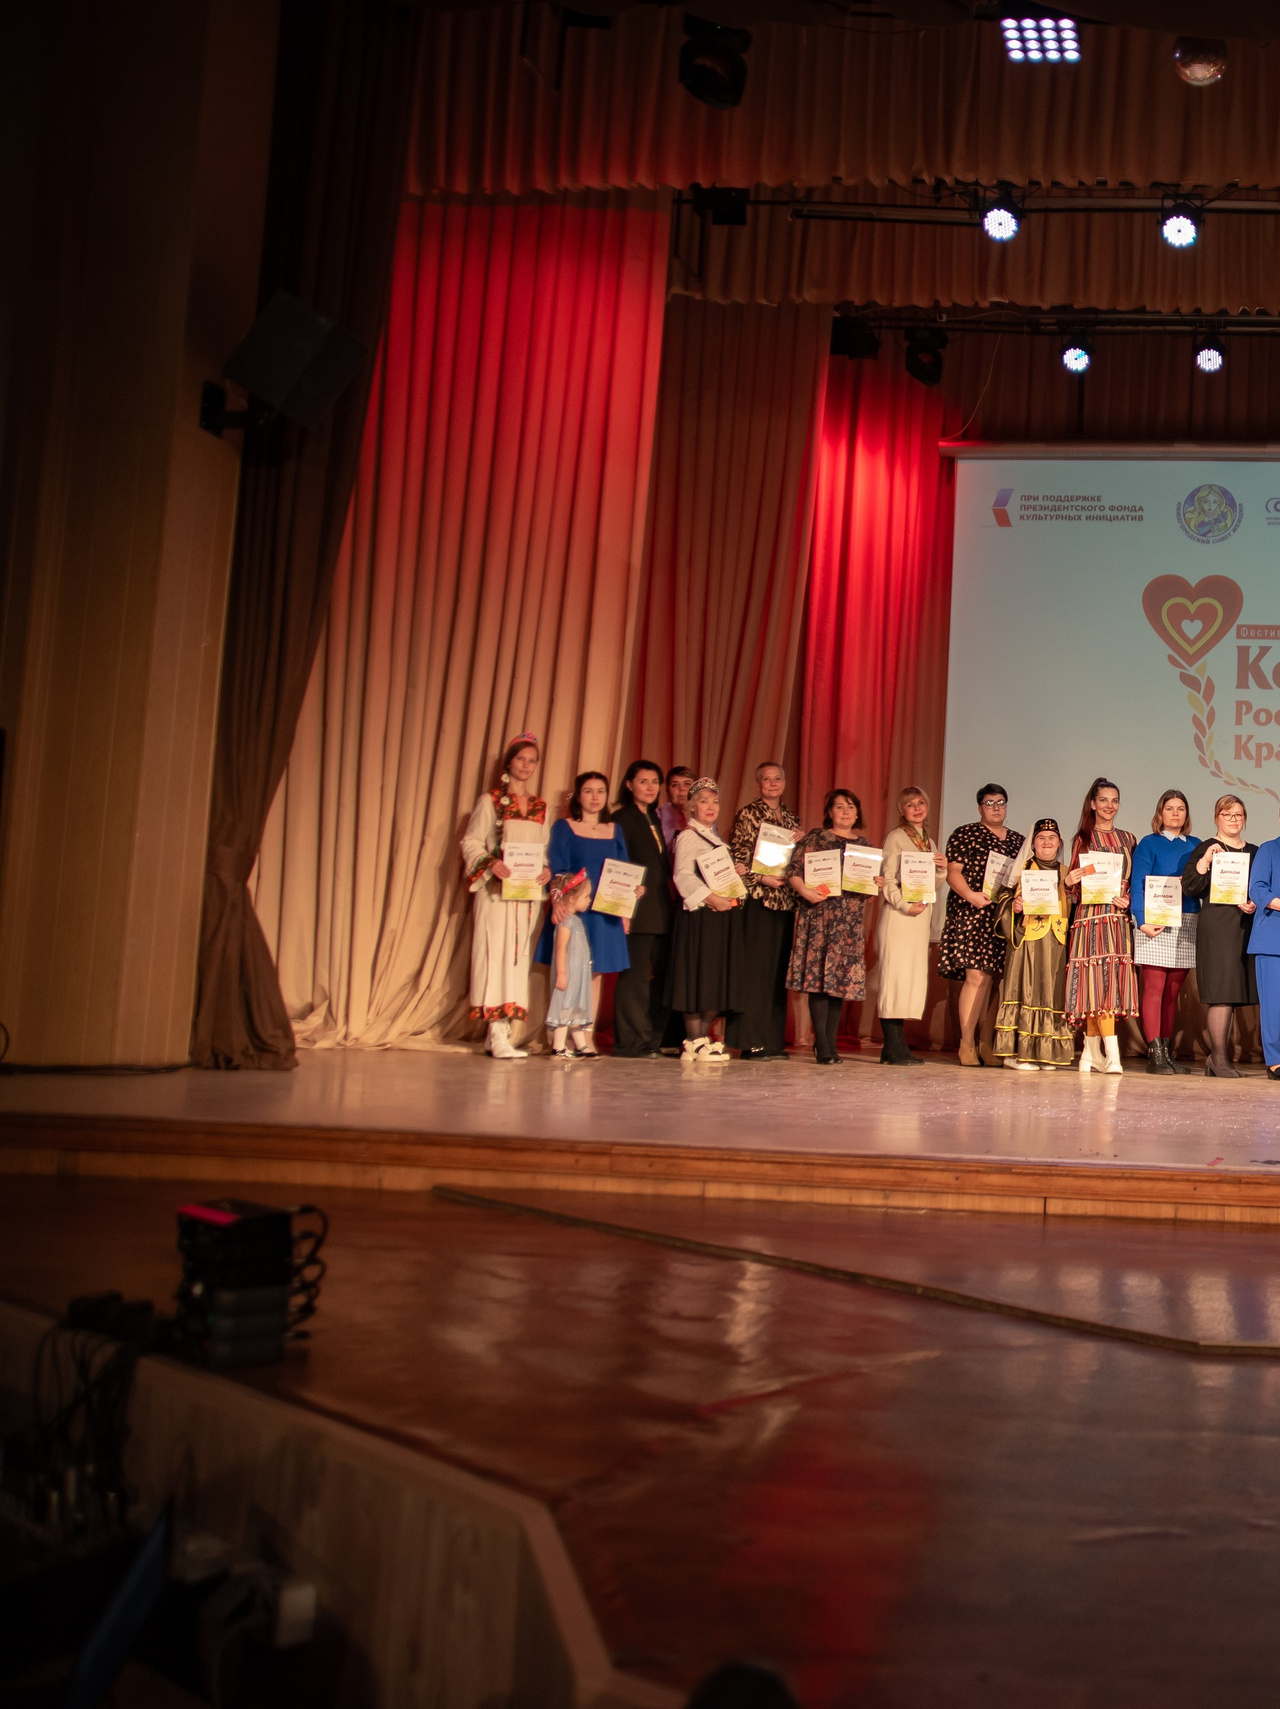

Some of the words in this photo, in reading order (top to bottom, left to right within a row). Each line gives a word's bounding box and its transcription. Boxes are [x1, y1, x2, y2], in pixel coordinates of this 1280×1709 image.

[1020, 494, 1039, 502] ПРИ
[1042, 494, 1102, 503] ПОДДЕРЖКЕ
[1020, 504, 1105, 513] ПРЕЗИДЕНТСКОГО
[1108, 504, 1144, 513] ФОНДА
[1019, 513, 1082, 522] КУЛЬТУРНЫХ
[1085, 514, 1144, 523] ИНИЦИАТИВ
